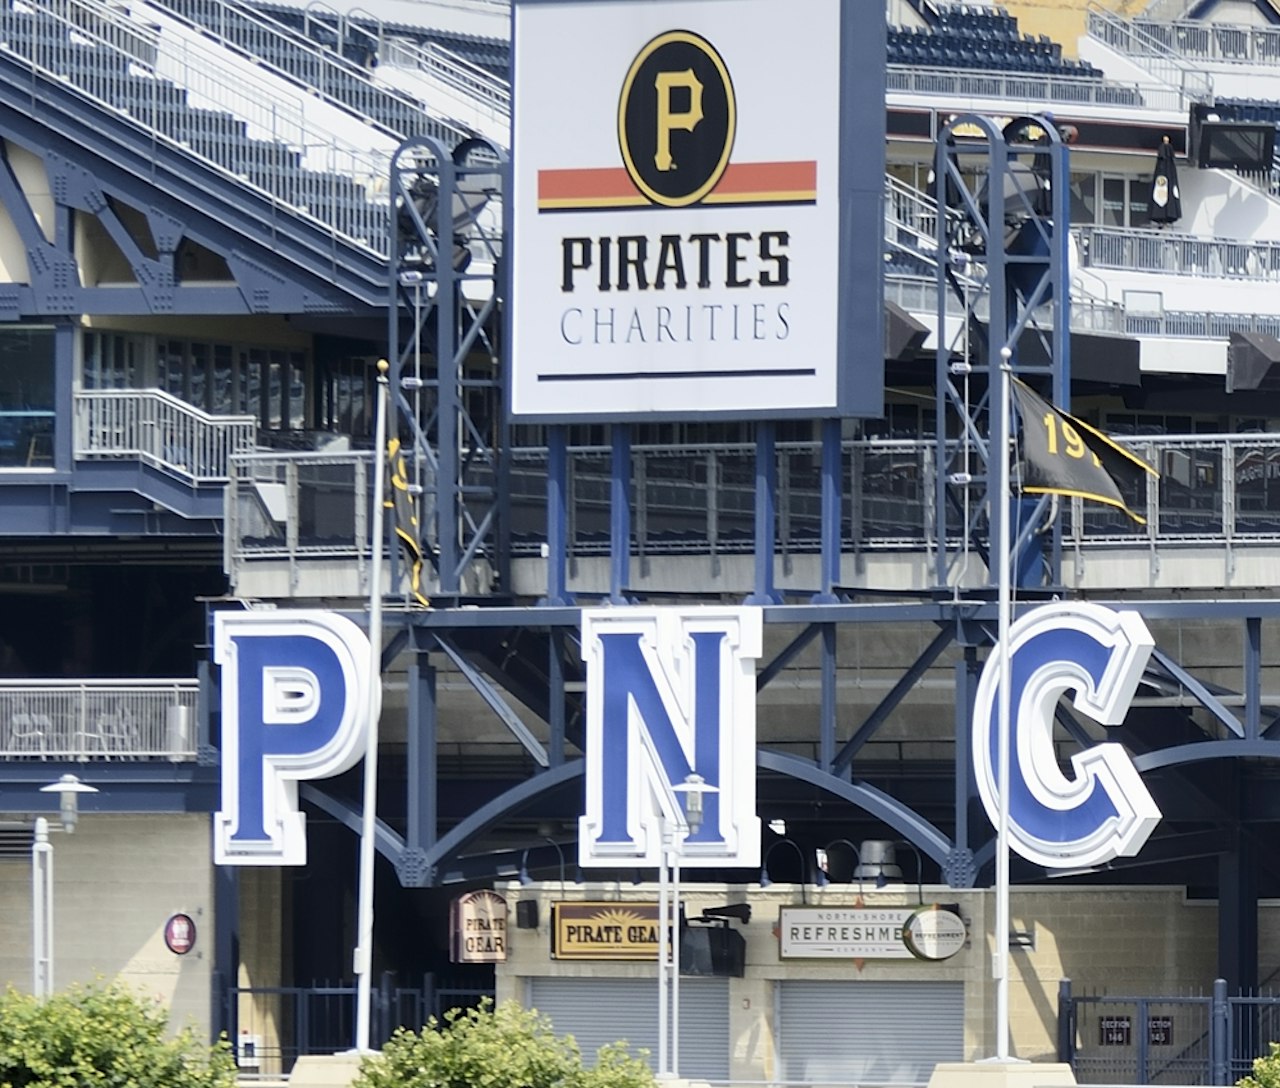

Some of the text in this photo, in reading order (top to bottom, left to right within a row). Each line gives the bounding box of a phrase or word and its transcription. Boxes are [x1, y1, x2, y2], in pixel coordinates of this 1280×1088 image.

[654, 67, 704, 171] P
[560, 231, 790, 292] PIRATES
[560, 302, 790, 345] CHARITIES
[213, 600, 1162, 868] PNC
[465, 936, 505, 953] GEAR
[466, 917, 505, 931] PIRATE
[565, 925, 623, 943] PIRATE
